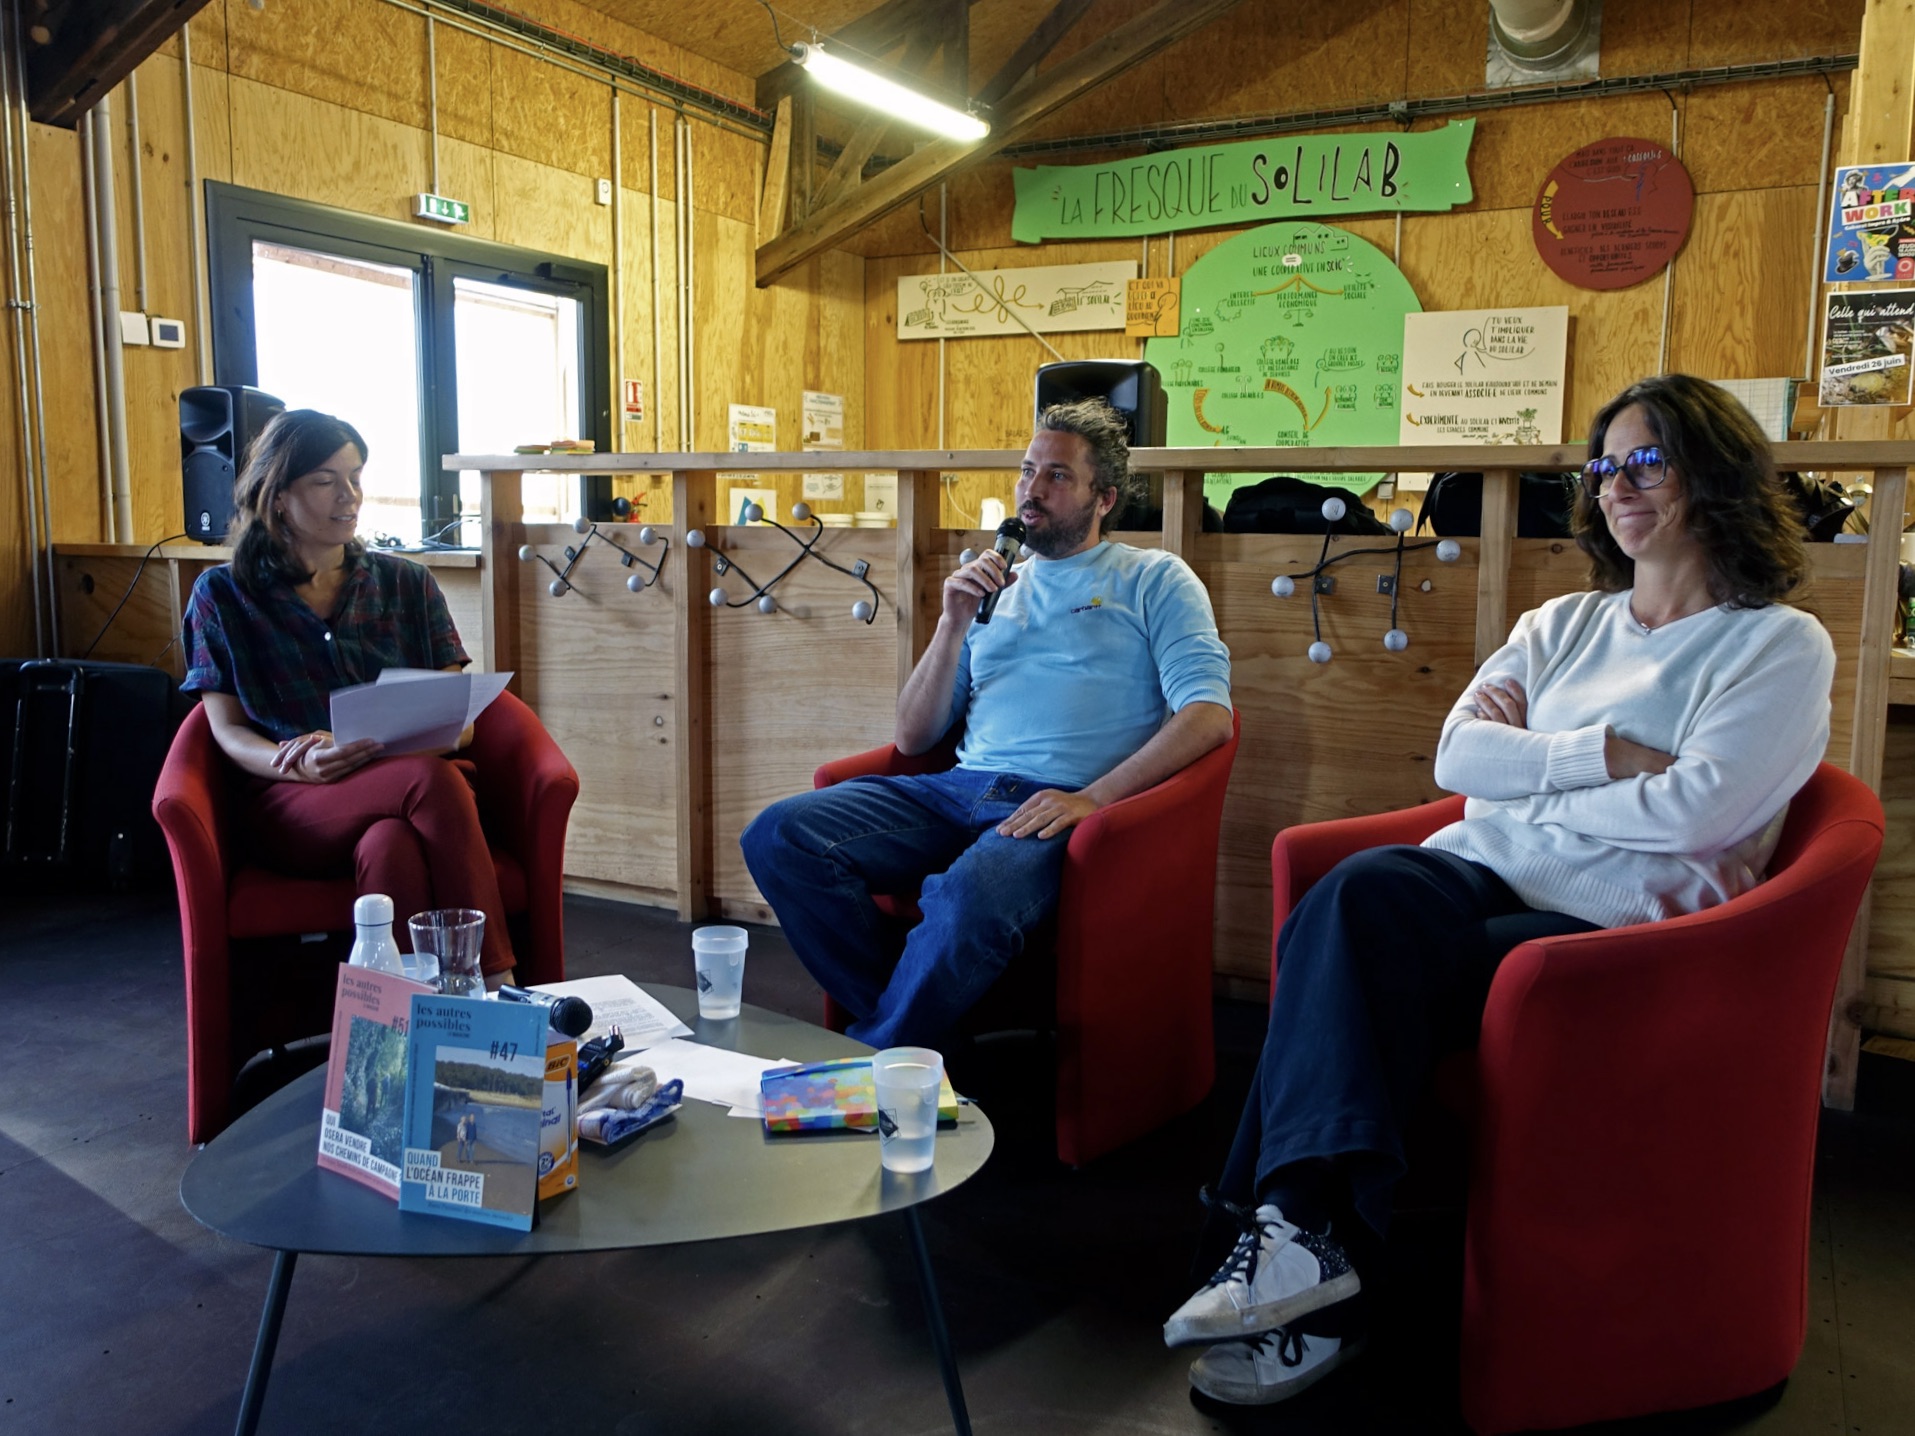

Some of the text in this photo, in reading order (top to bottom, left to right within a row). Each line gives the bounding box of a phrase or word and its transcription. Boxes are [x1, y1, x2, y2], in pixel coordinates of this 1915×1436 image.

[1061, 196, 1083, 224] LA
[1094, 153, 1224, 225] FRESQUE
[1230, 183, 1248, 209] DU
[1841, 188, 1915, 207] AFTER
[1540, 195, 1553, 225] POUR
[1845, 201, 1908, 223] WORK
[1253, 241, 1326, 258] LIEUX COMMUNS
[1253, 265, 1267, 277] UNE
[1829, 302, 1914, 324] Celle qui attend
[1491, 336, 1527, 344] DANS LA VIE
[1829, 357, 1902, 375] Vendredi 26 juin
[343, 973, 382, 994] les autres
[341, 987, 380, 1005] possibles
[417, 1002, 472, 1020] les autres
[391, 1015, 410, 1037] #51
[416, 1017, 471, 1032] possibles
[490, 1039, 518, 1062] #47
[326, 1114, 336, 1127] QUI
[540, 1112, 561, 1128] inal
[324, 1127, 367, 1153] OSERA VENDRE
[323, 1140, 335, 1154] NOS
[335, 1145, 361, 1164] CHEMINS
[362, 1155, 370, 1167] DE
[370, 1157, 398, 1182] CAMPAGNE
[407, 1151, 439, 1167] QUAND
[406, 1166, 444, 1184] L'OCÉAN
[446, 1172, 481, 1190] FRAPPE
[428, 1181, 480, 1206] À LA PORTE
